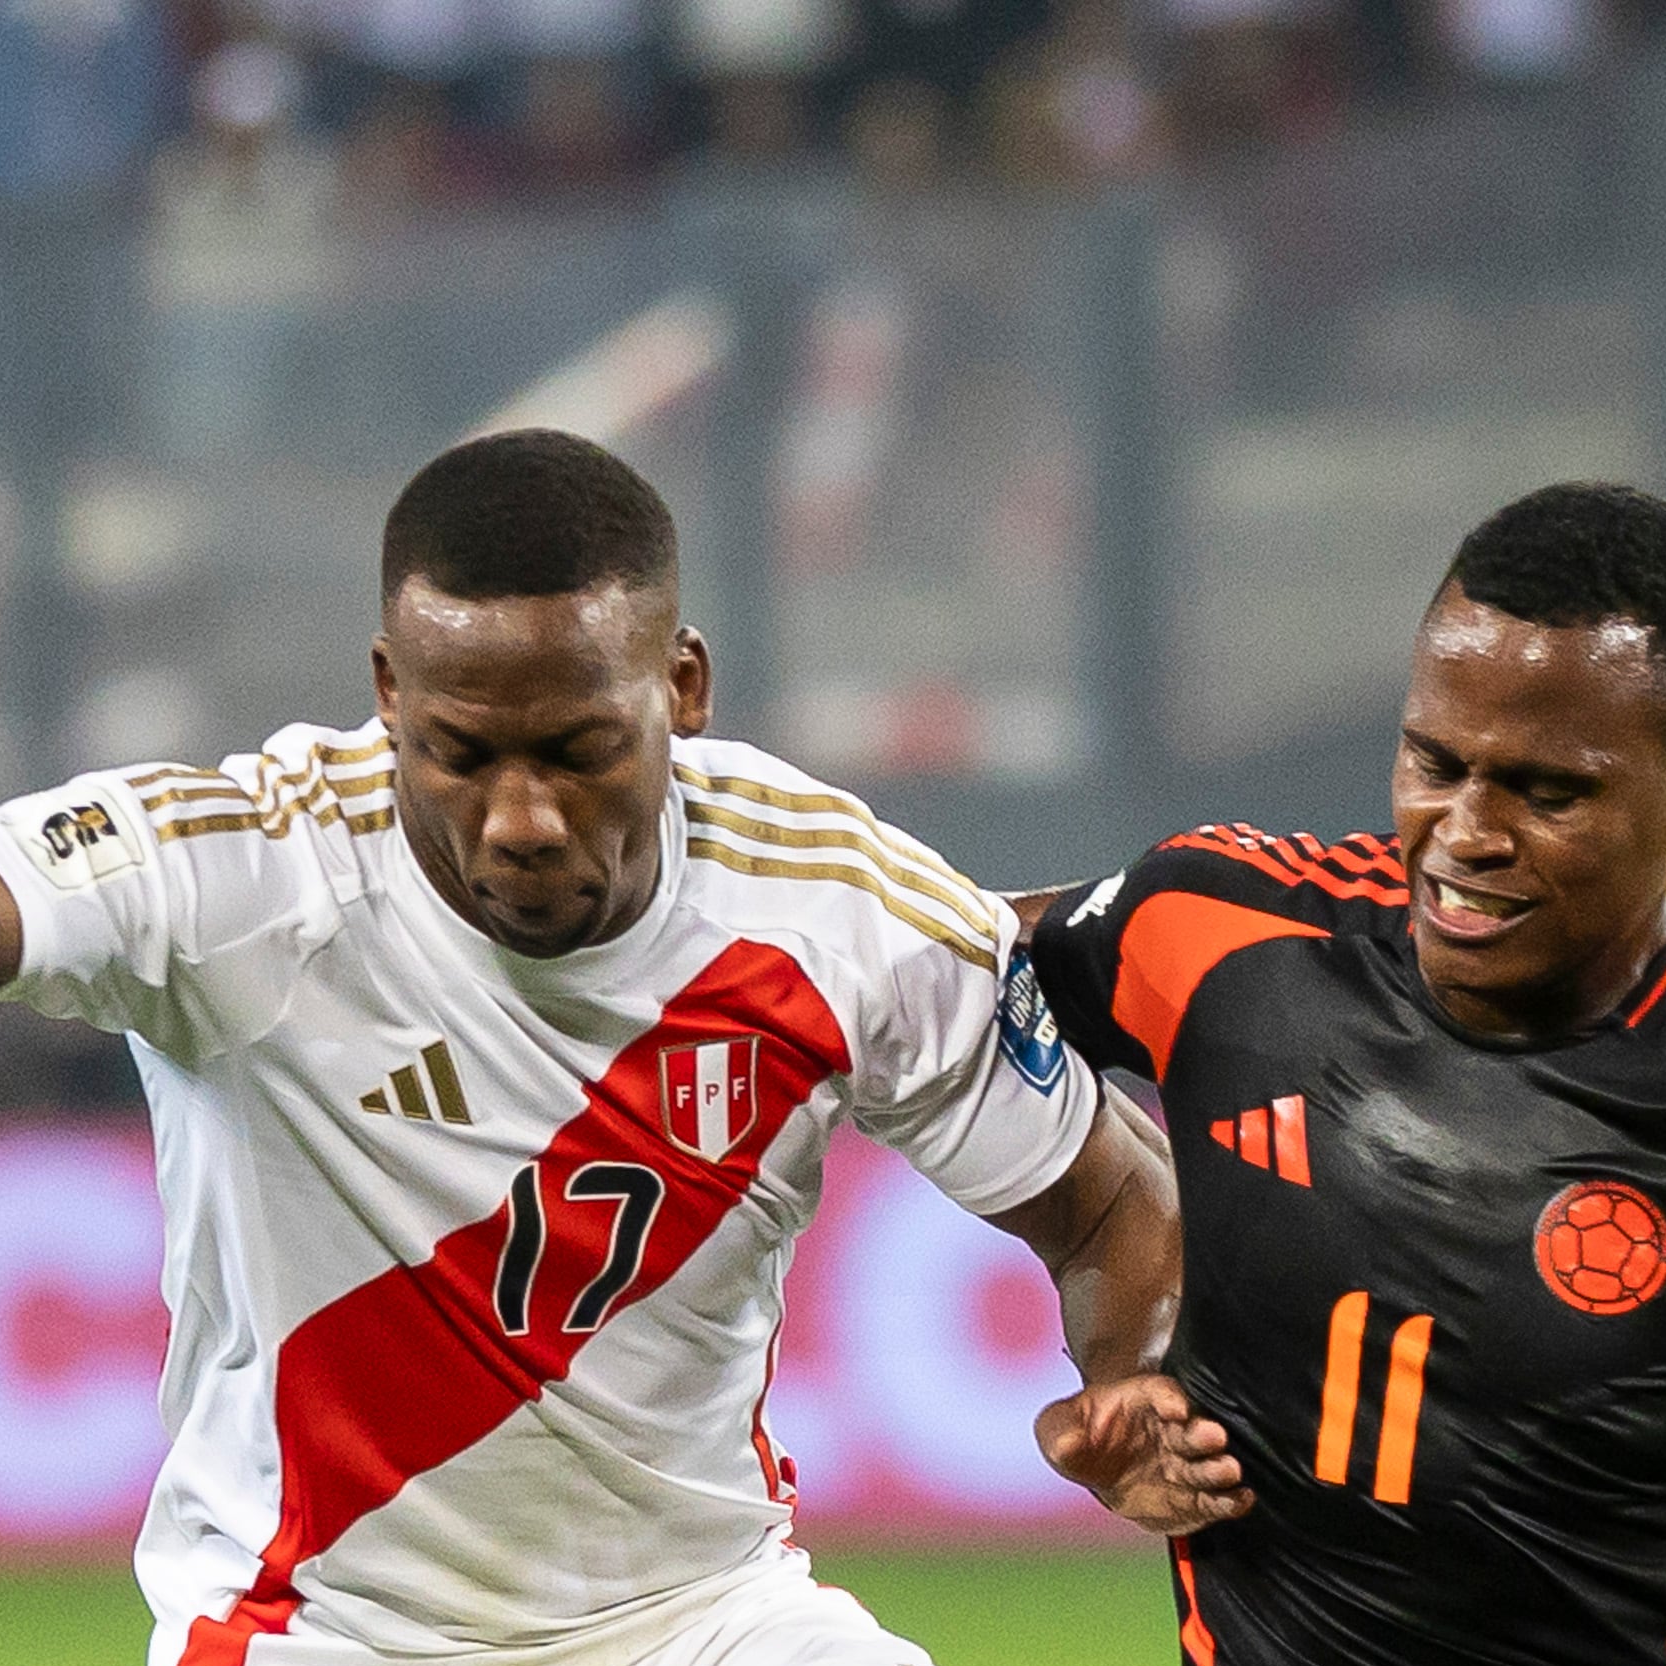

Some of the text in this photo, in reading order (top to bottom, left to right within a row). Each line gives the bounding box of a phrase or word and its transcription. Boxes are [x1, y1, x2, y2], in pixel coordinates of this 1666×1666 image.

[676, 1077, 746, 1109] FPF
[493, 1162, 665, 1336] 17
[1314, 1291, 1433, 1505] 11
